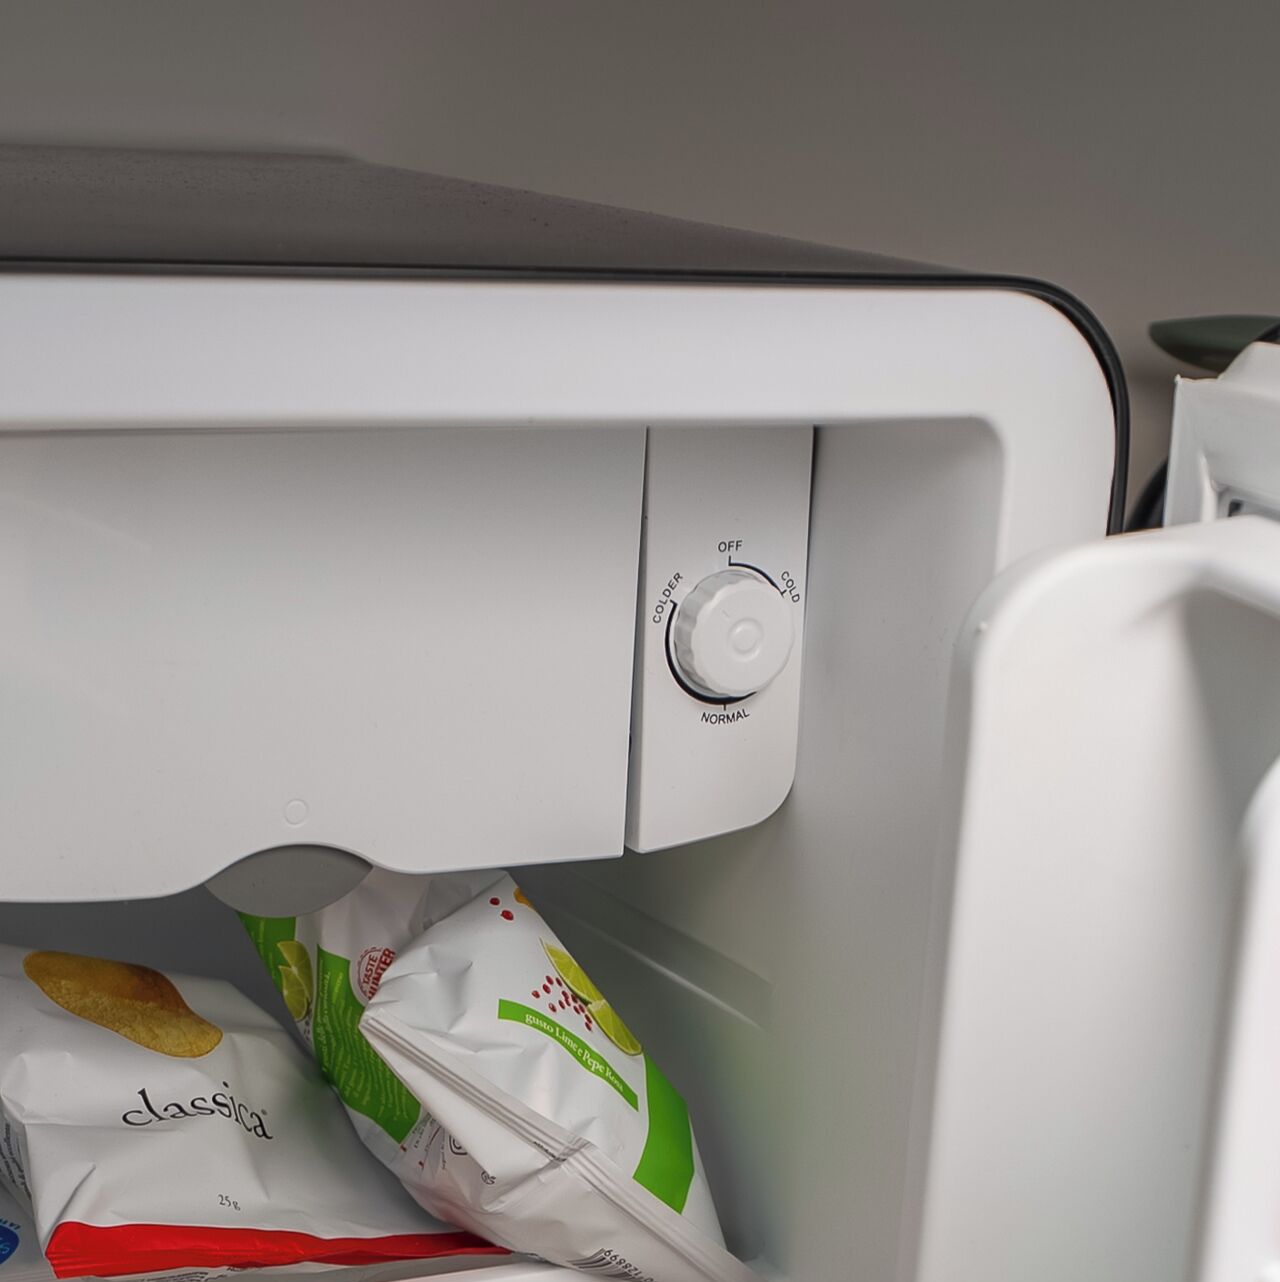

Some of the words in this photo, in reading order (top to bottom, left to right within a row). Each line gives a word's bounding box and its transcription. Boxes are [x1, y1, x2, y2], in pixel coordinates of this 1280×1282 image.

[717, 539, 743, 553] OFF
[652, 572, 683, 624] COLDER
[780, 570, 801, 604] COLD
[700, 708, 750, 725] NORMAL
[362, 953, 379, 985] TASTE
[368, 947, 396, 1001] HUNTER
[525, 1012, 554, 1033] gusto
[555, 1027, 578, 1051] Lime
[577, 1048, 583, 1057] e
[582, 1050, 606, 1073] Pepe
[122, 1081, 273, 1140] classica
